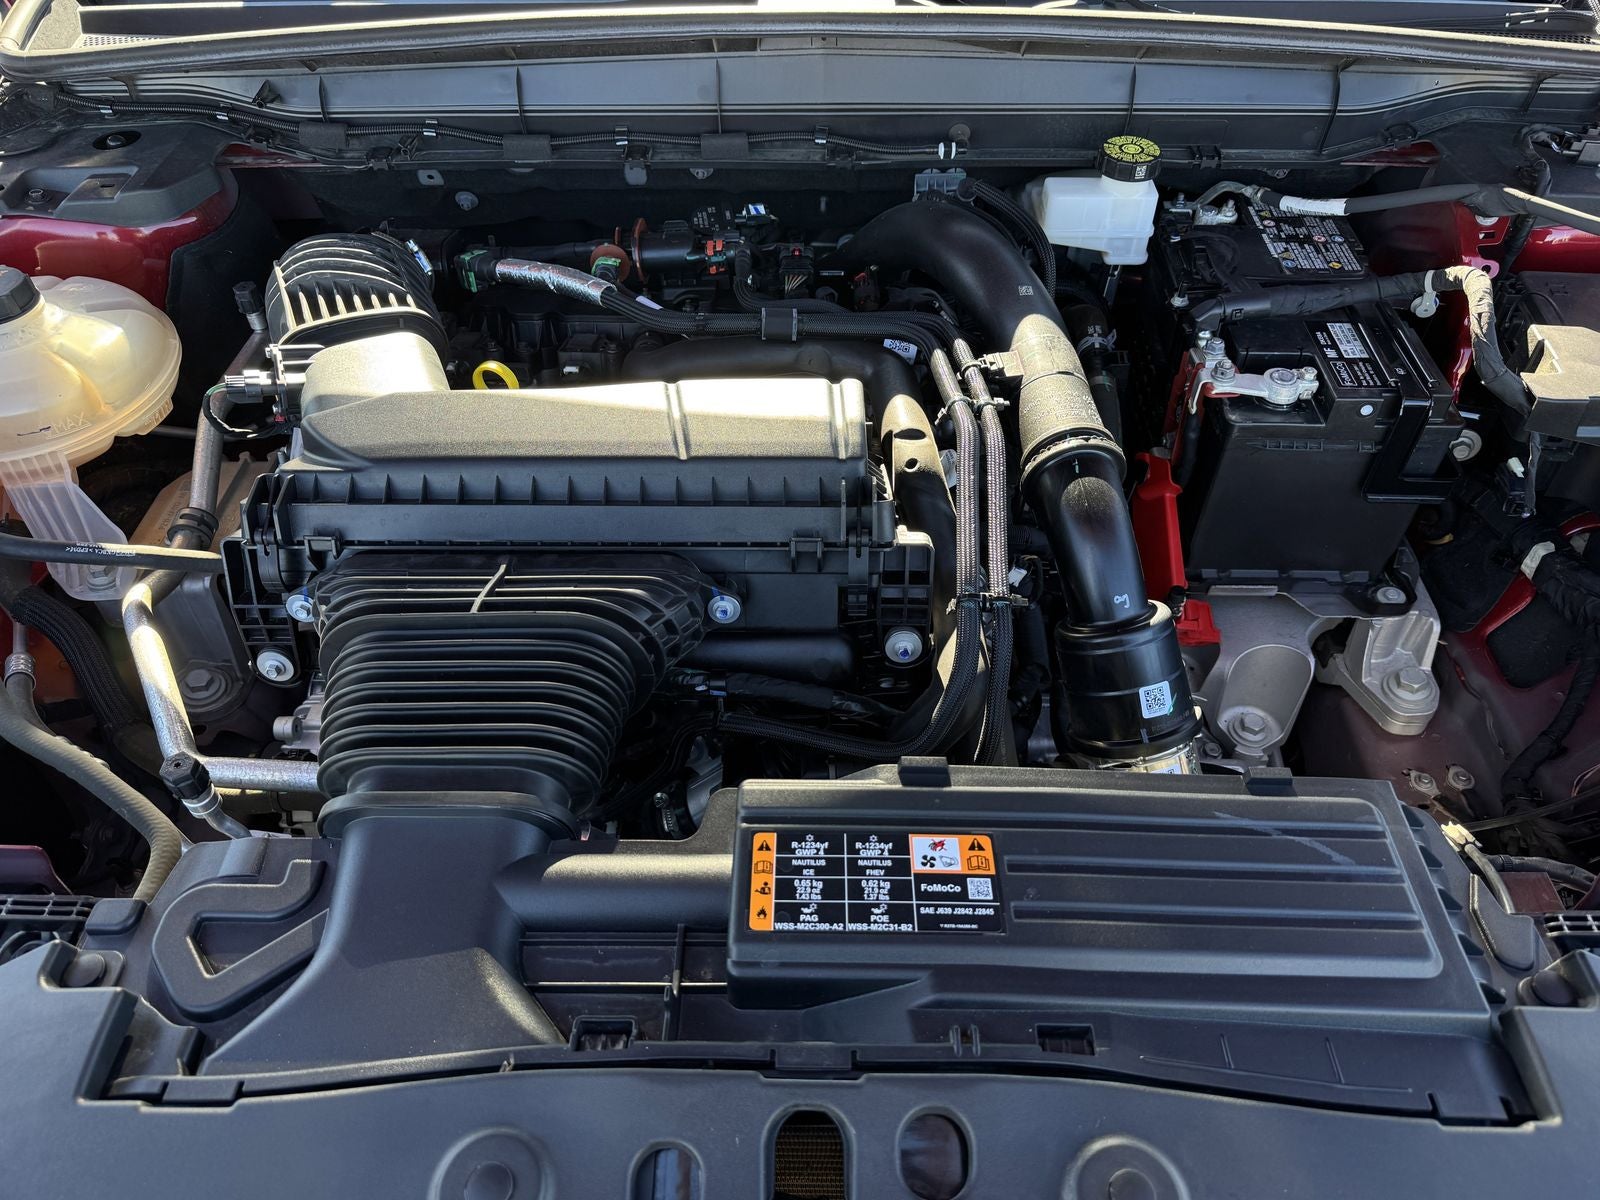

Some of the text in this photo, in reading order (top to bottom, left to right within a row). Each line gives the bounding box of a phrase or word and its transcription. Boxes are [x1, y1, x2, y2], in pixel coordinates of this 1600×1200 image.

[50, 411, 91, 435] MAX
[791, 841, 829, 850] R-1234yf
[855, 841, 893, 850] R-1234yf
[859, 849, 889, 857] GWP 4
[802, 868, 815, 876] ICE
[794, 879, 823, 889] 0.65 kg
[880, 880, 891, 889] kg
[920, 883, 962, 892] FoMoCo
[878, 893, 890, 901] lbs
[935, 907, 952, 915] J639
[799, 914, 819, 922] PAG
[870, 914, 890, 922] POE
[774, 922, 844, 930] WSS-M2C300-A2
[848, 923, 913, 931] WSS-M2C31-B2
